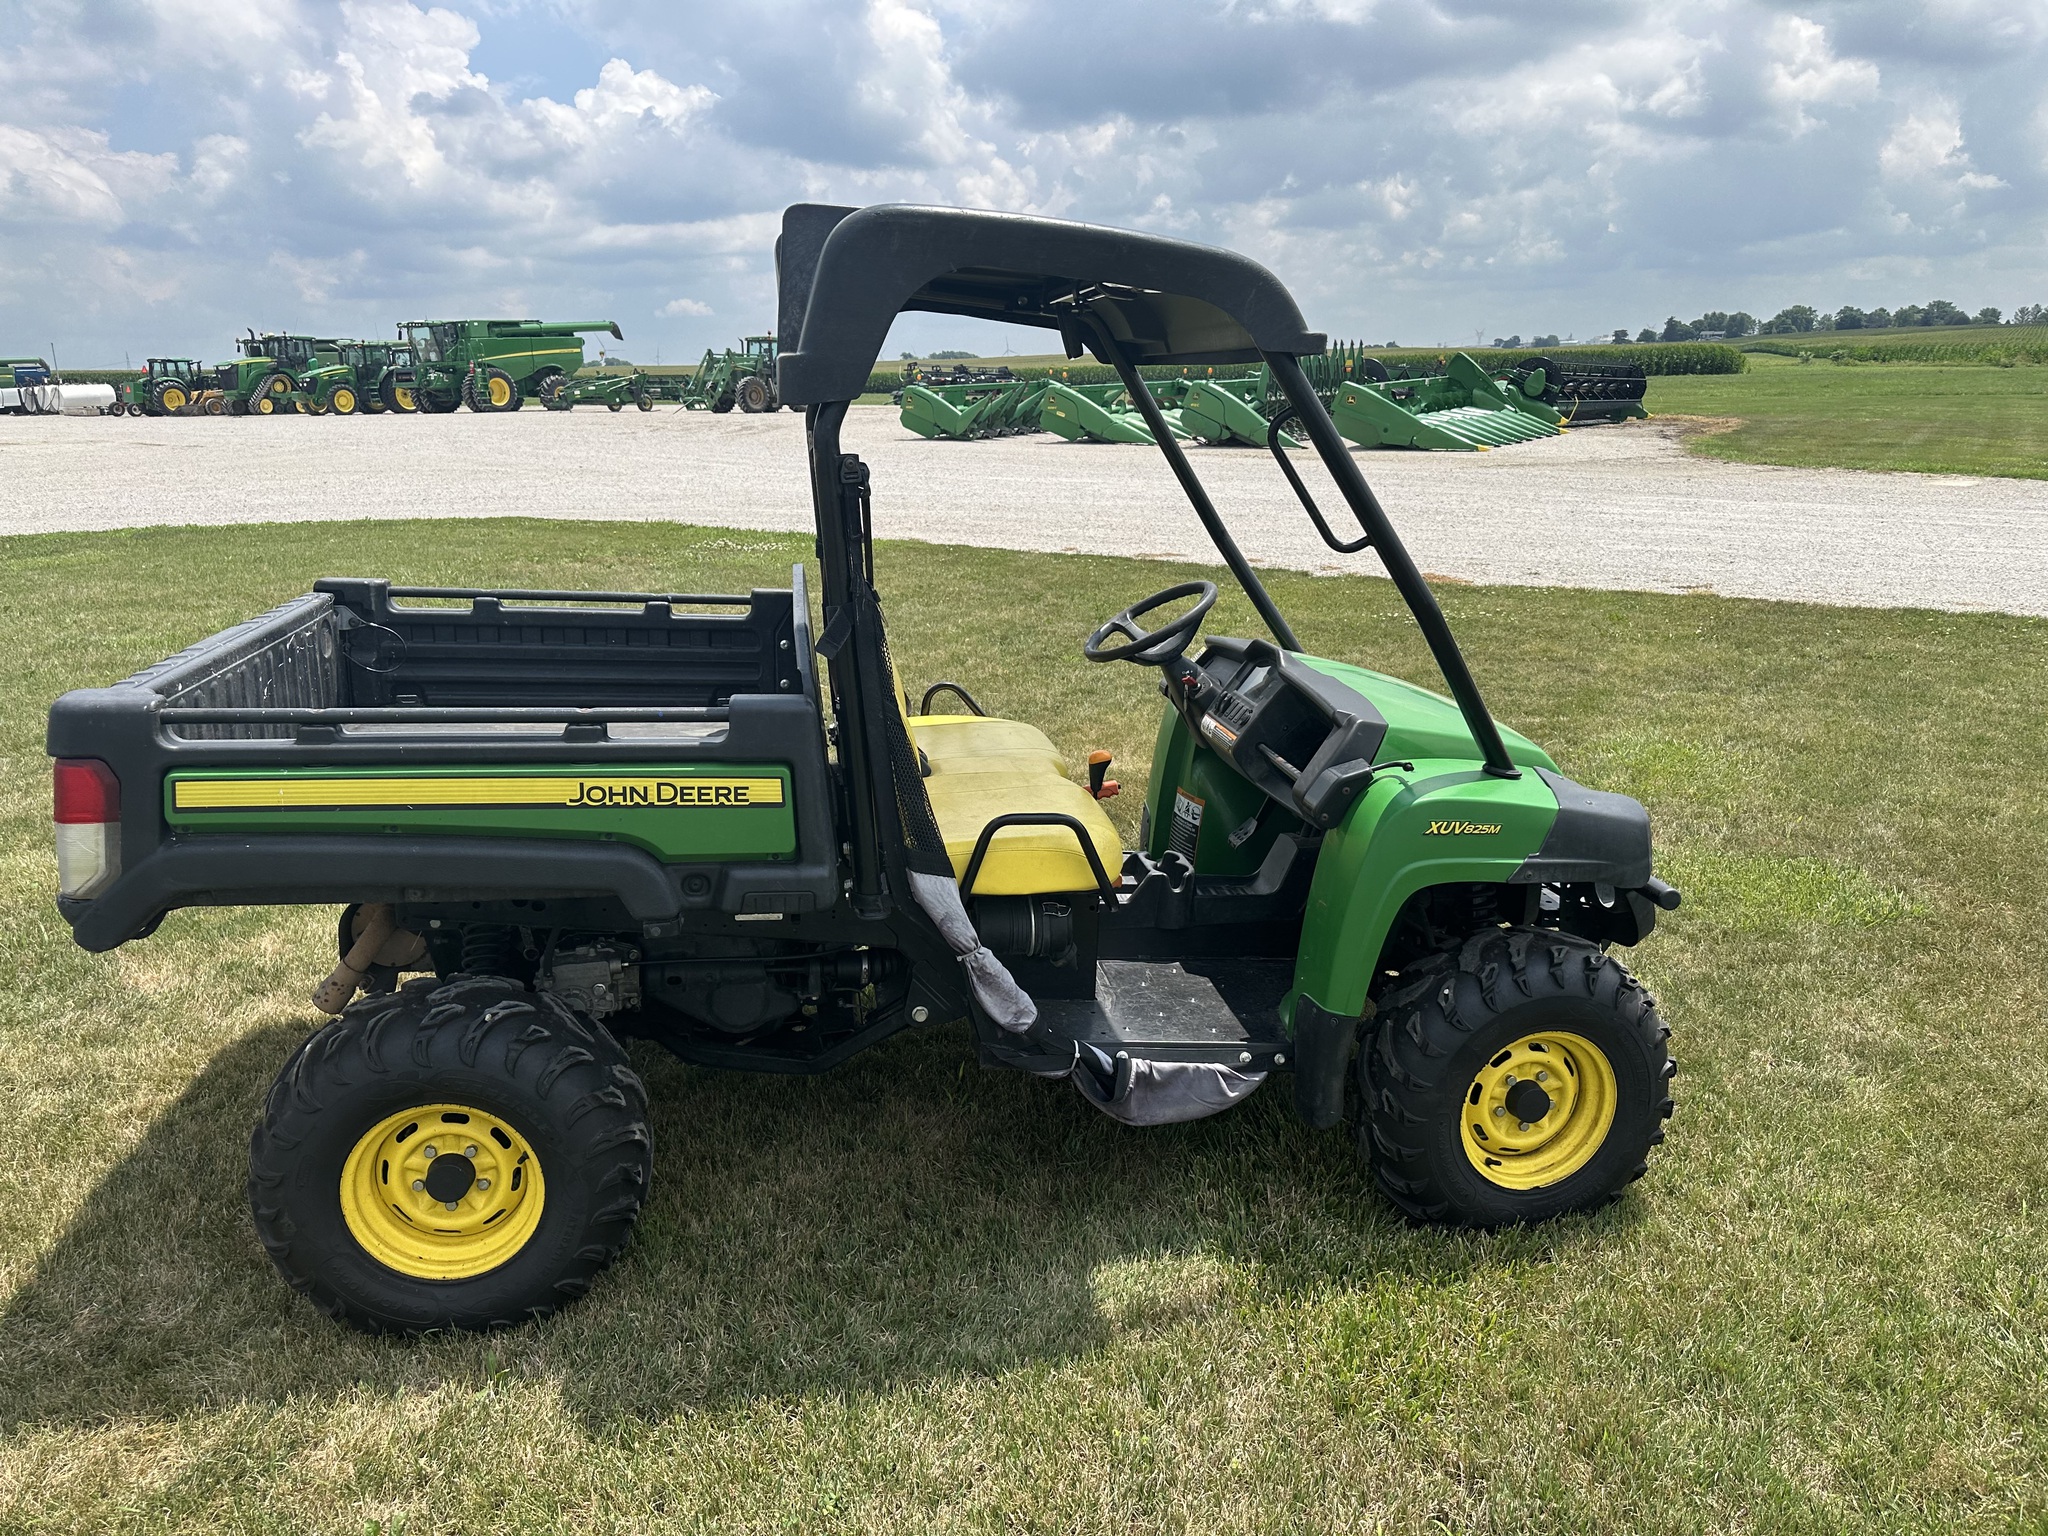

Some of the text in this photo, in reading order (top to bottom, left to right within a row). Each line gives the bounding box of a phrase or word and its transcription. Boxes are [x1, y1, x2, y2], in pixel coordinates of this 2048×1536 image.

[568, 782, 750, 803] JOHN DEERE
[1424, 820, 1502, 835] XUV825M
